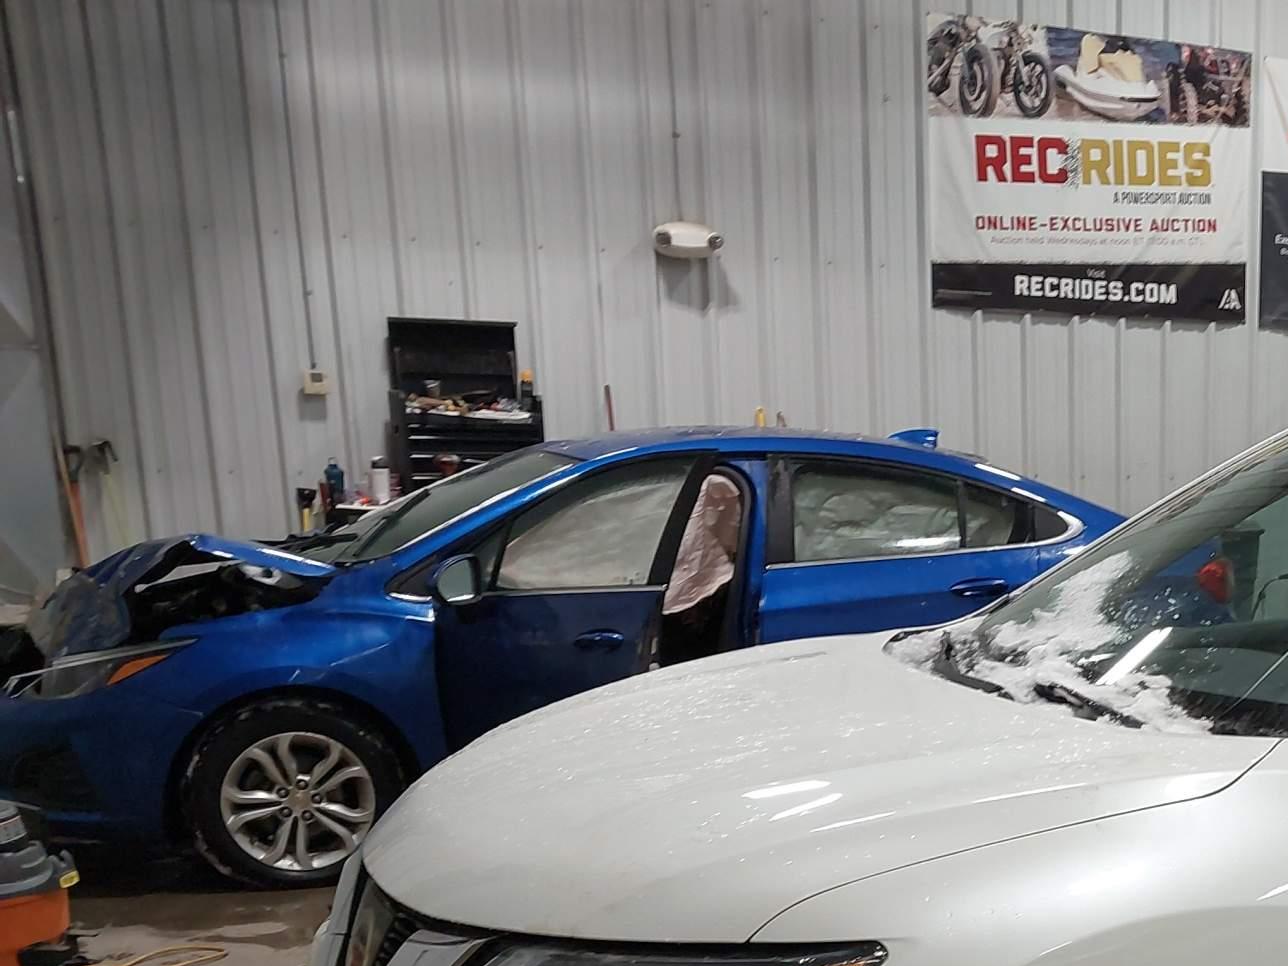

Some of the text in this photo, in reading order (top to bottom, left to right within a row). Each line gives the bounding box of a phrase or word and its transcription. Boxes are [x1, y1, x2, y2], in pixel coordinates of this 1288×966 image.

[975, 135, 1212, 187] REC RIDES
[1113, 192, 1211, 205] A POWERSPORT AUCTION
[976, 216, 1216, 232] ONLINE-EXCLUSIVE AUCTION
[1086, 268, 1106, 278] Visit
[1014, 274, 1178, 304] RECRIDES.COM
